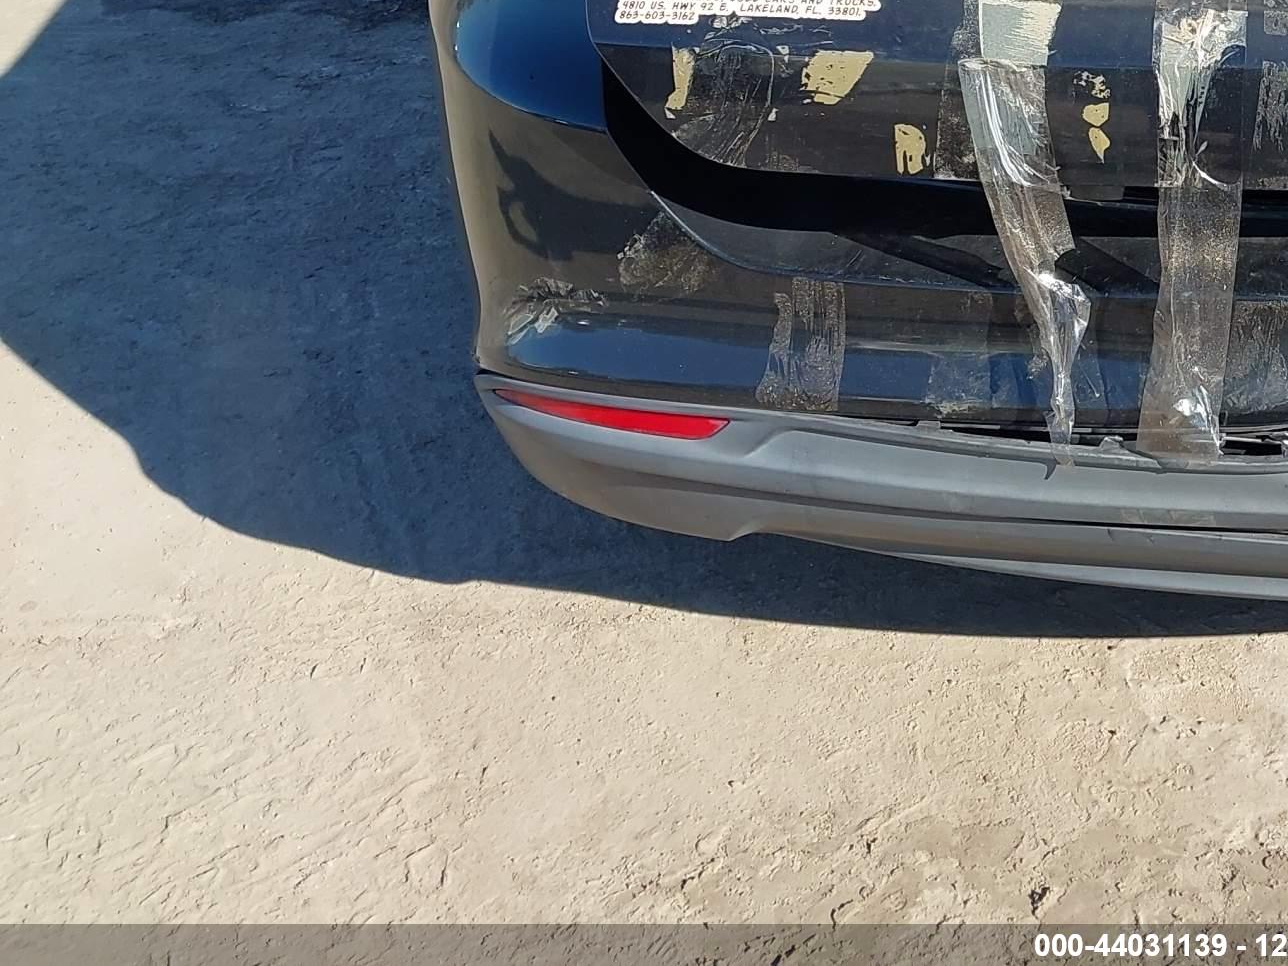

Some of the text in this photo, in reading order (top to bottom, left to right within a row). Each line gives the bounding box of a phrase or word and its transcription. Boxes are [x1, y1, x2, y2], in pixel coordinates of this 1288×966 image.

[672, 2, 695, 11] HWY
[700, 3, 714, 11] 92
[719, 3, 729, 12] E.
[619, 10, 696, 21] 863-603-3162
